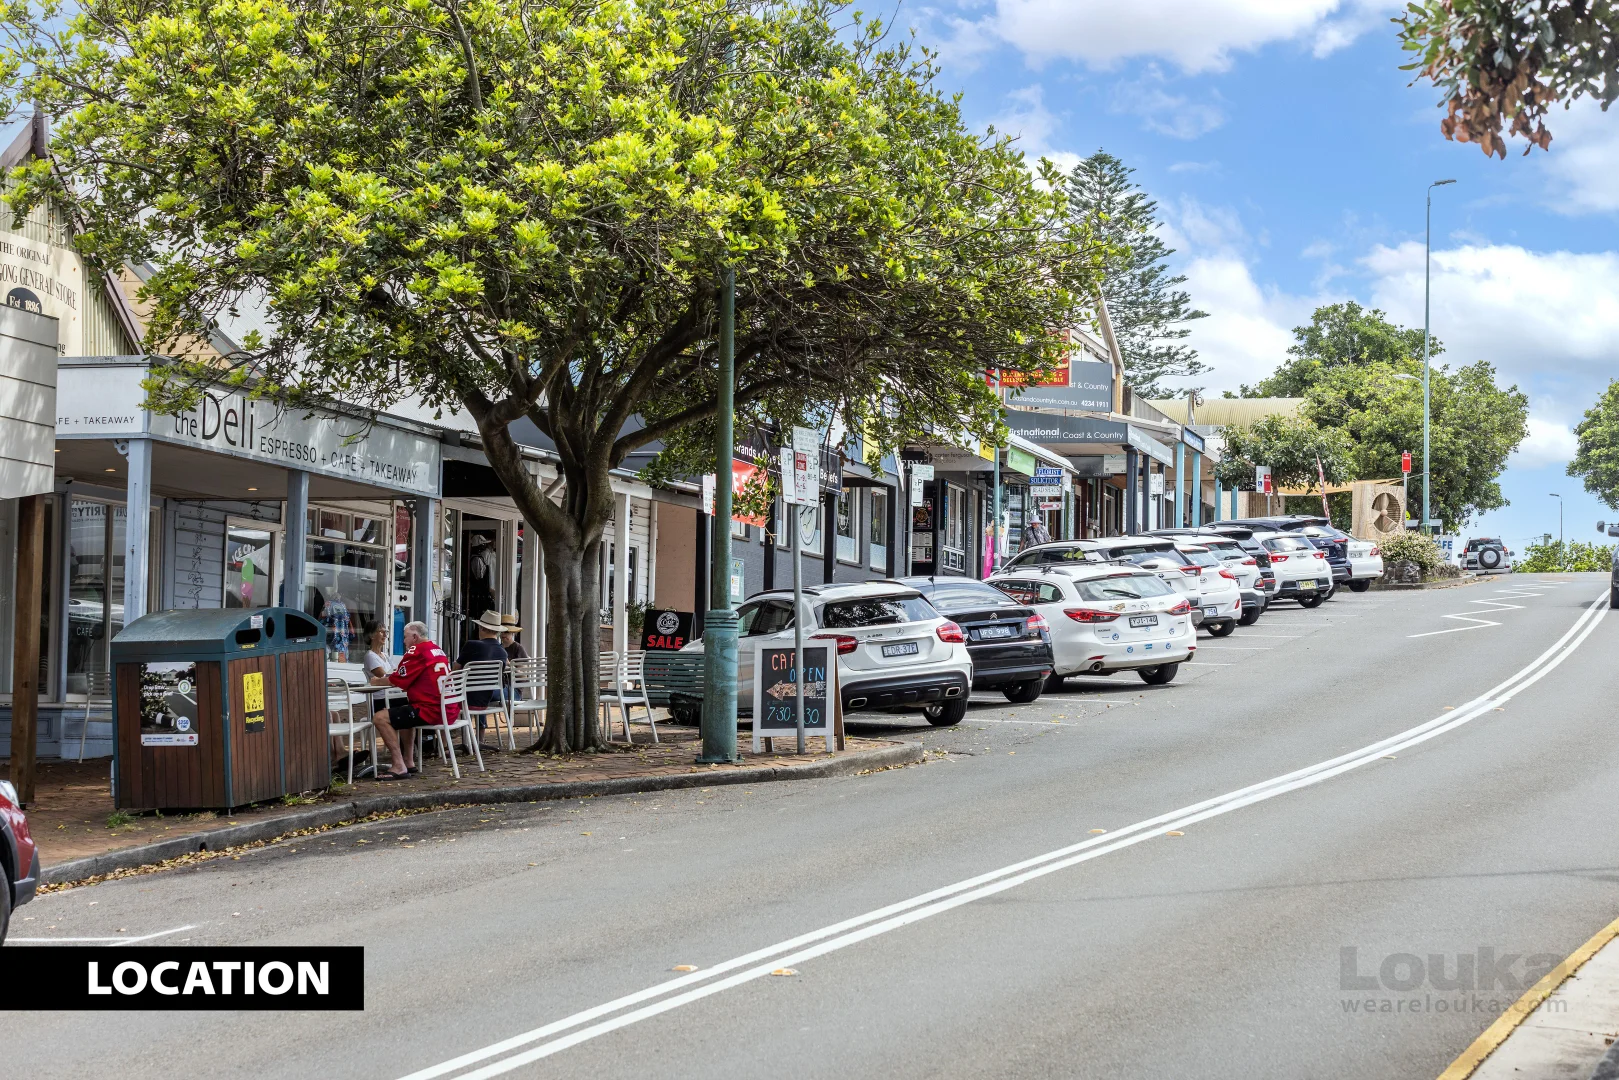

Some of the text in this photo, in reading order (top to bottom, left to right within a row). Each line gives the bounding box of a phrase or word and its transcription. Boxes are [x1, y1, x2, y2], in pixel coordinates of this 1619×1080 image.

[16, 245, 50, 266] ORIGINAL
[20, 265, 54, 296] GENERAL
[55, 281, 77, 311] STORE
[25, 299, 40, 314] 1886
[1084, 382, 1109, 392] Country
[1081, 399, 1095, 408] 4234
[1096, 400, 1109, 408] 1911
[56, 416, 70, 425] FE
[84, 416, 135, 425] TAKEAWAY
[175, 391, 254, 450] the Deli
[1062, 431, 1085, 440] Coast
[1086, 432, 1093, 440] &
[1094, 431, 1124, 442] Country
[260, 436, 317, 464] ESPRESSO
[321, 454, 327, 466] +
[331, 451, 357, 473] CAFE
[370, 460, 417, 485] TAKEAWAY
[820, 468, 838, 485] Beiefs
[1038, 468, 1060, 476] FLORIST
[231, 547, 243, 565] ICE
[76, 627, 93, 637] CAFE
[647, 634, 684, 649] SALE
[771, 652, 796, 671] CAF
[767, 706, 820, 724] 7:30-:30
